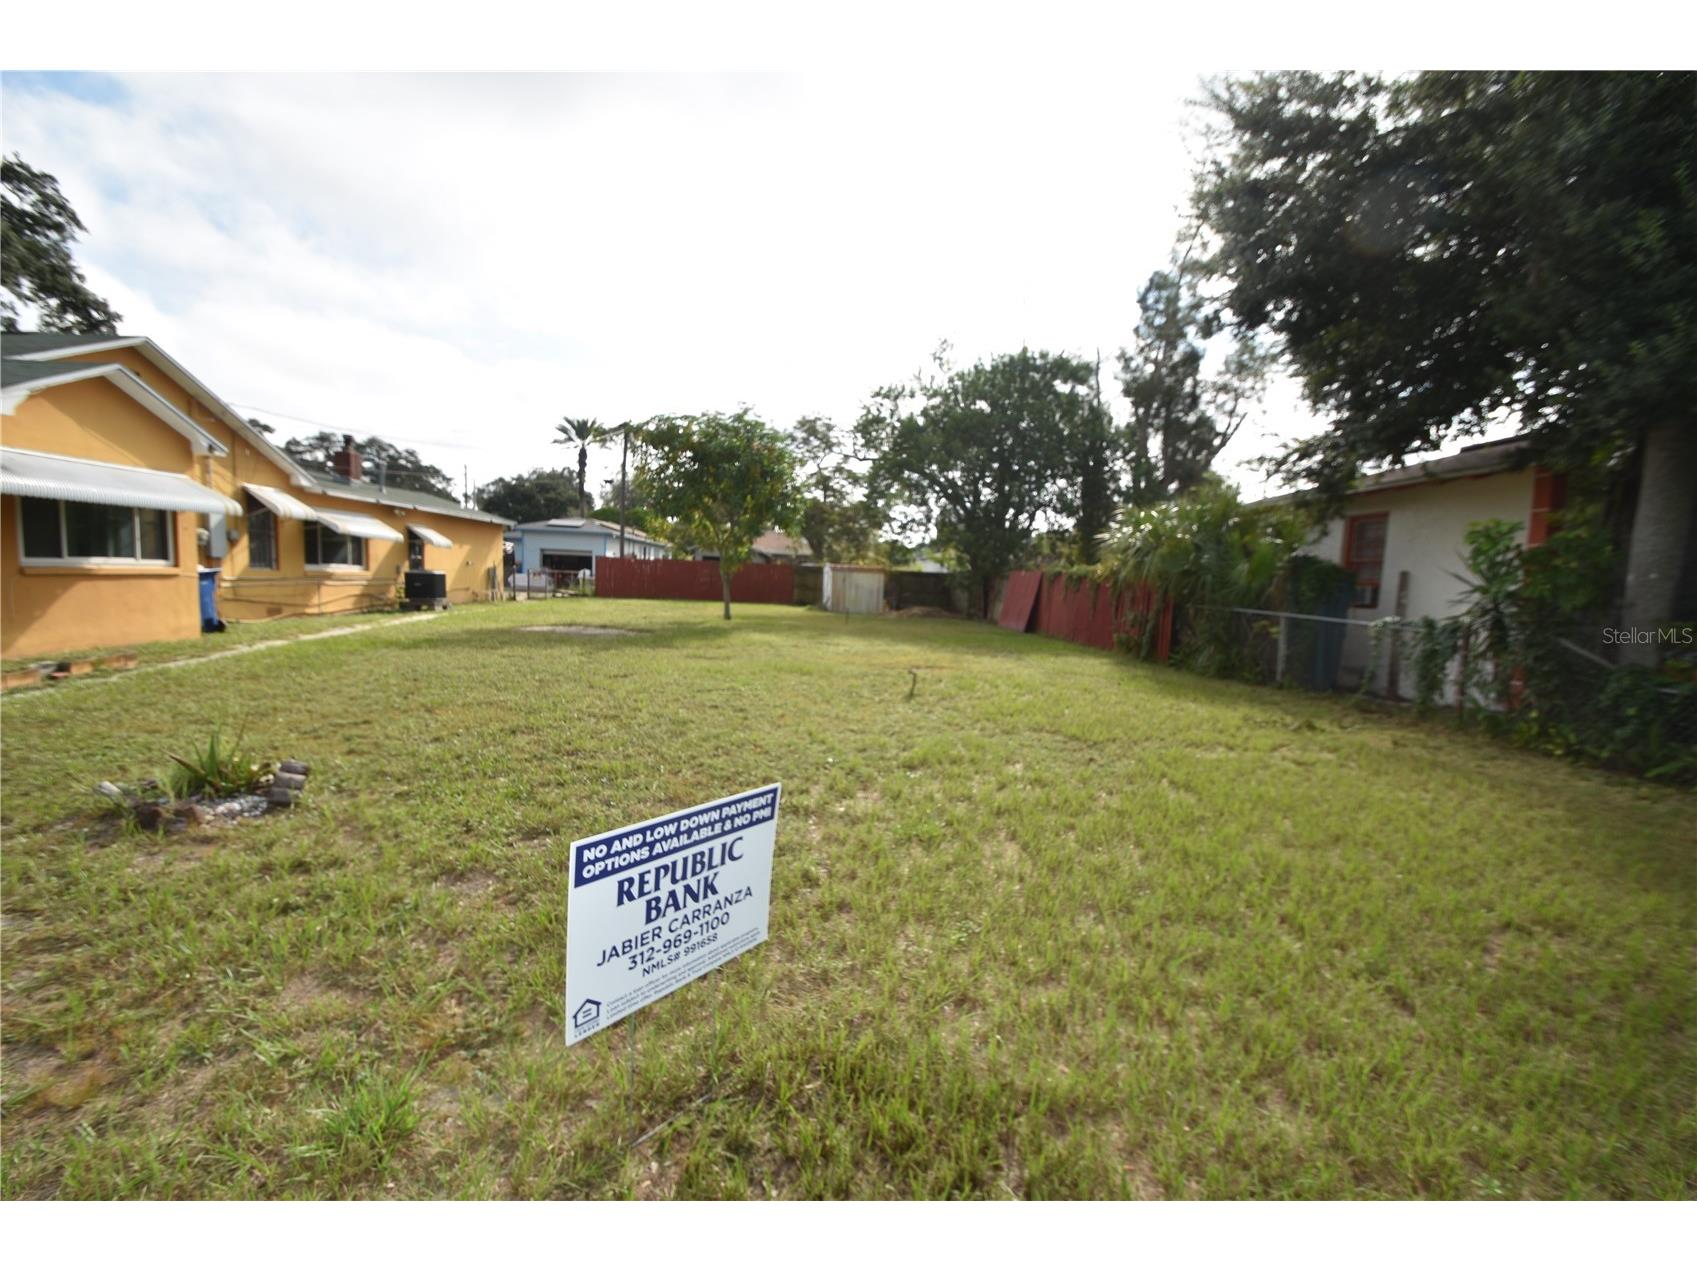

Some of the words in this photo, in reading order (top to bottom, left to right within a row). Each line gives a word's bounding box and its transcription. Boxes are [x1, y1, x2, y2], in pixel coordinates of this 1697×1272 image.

[582, 846, 650, 879] OPTIONS
[652, 822, 722, 854] AVAILABLE
[723, 820, 732, 831] &
[733, 813, 751, 827] NO
[752, 807, 772, 821] PMI
[583, 844, 607, 863] NO
[610, 834, 643, 854] AND
[645, 822, 678, 842] LOW
[680, 809, 720, 831] DOWN
[721, 793, 774, 818] PAYMENT
[616, 836, 744, 907] REPUBLIC
[644, 871, 719, 925] BANK
[597, 926, 662, 967] JABIER
[668, 886, 752, 933] CARRANZA
[628, 911, 730, 971] 312-969-1100
